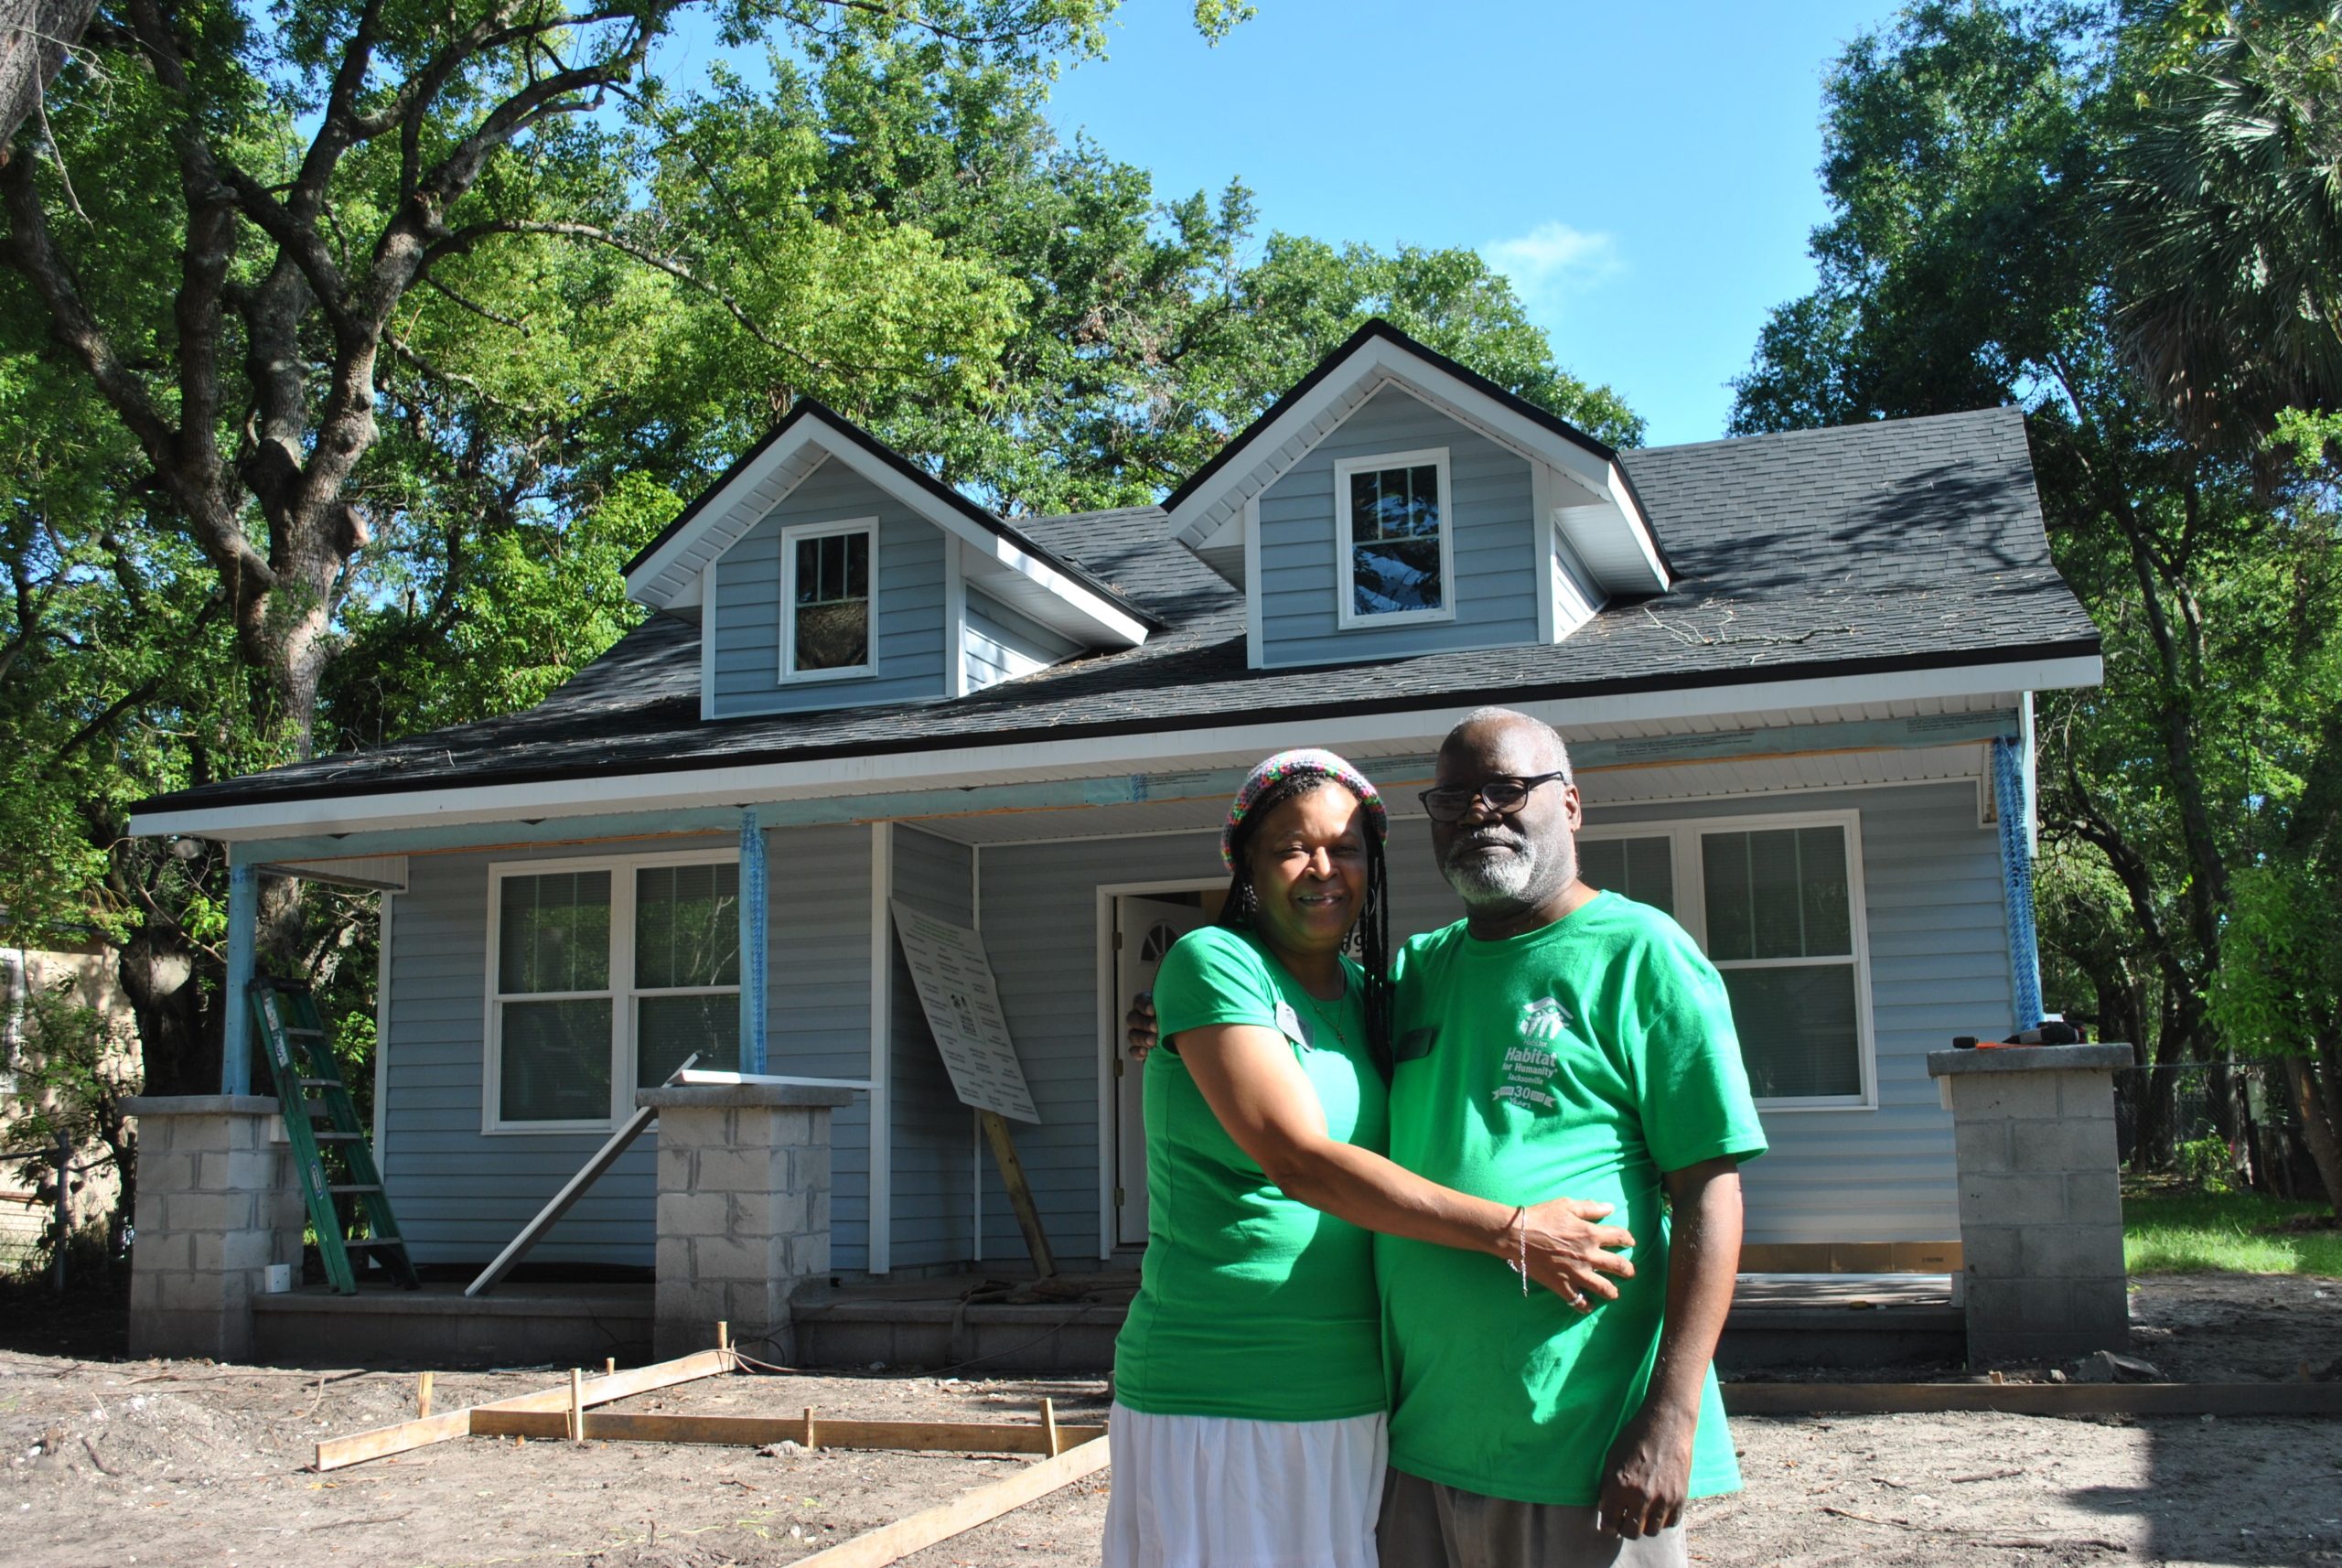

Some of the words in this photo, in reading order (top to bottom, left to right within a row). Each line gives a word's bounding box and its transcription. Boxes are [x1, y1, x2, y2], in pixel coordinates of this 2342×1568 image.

[1505, 1047, 1557, 1067] Habitat
[1501, 1062, 1513, 1071] for
[1508, 1072, 1543, 1085] Jacksonville
[1514, 1085, 1531, 1099] 30
[1509, 1096, 1531, 1109] Years
